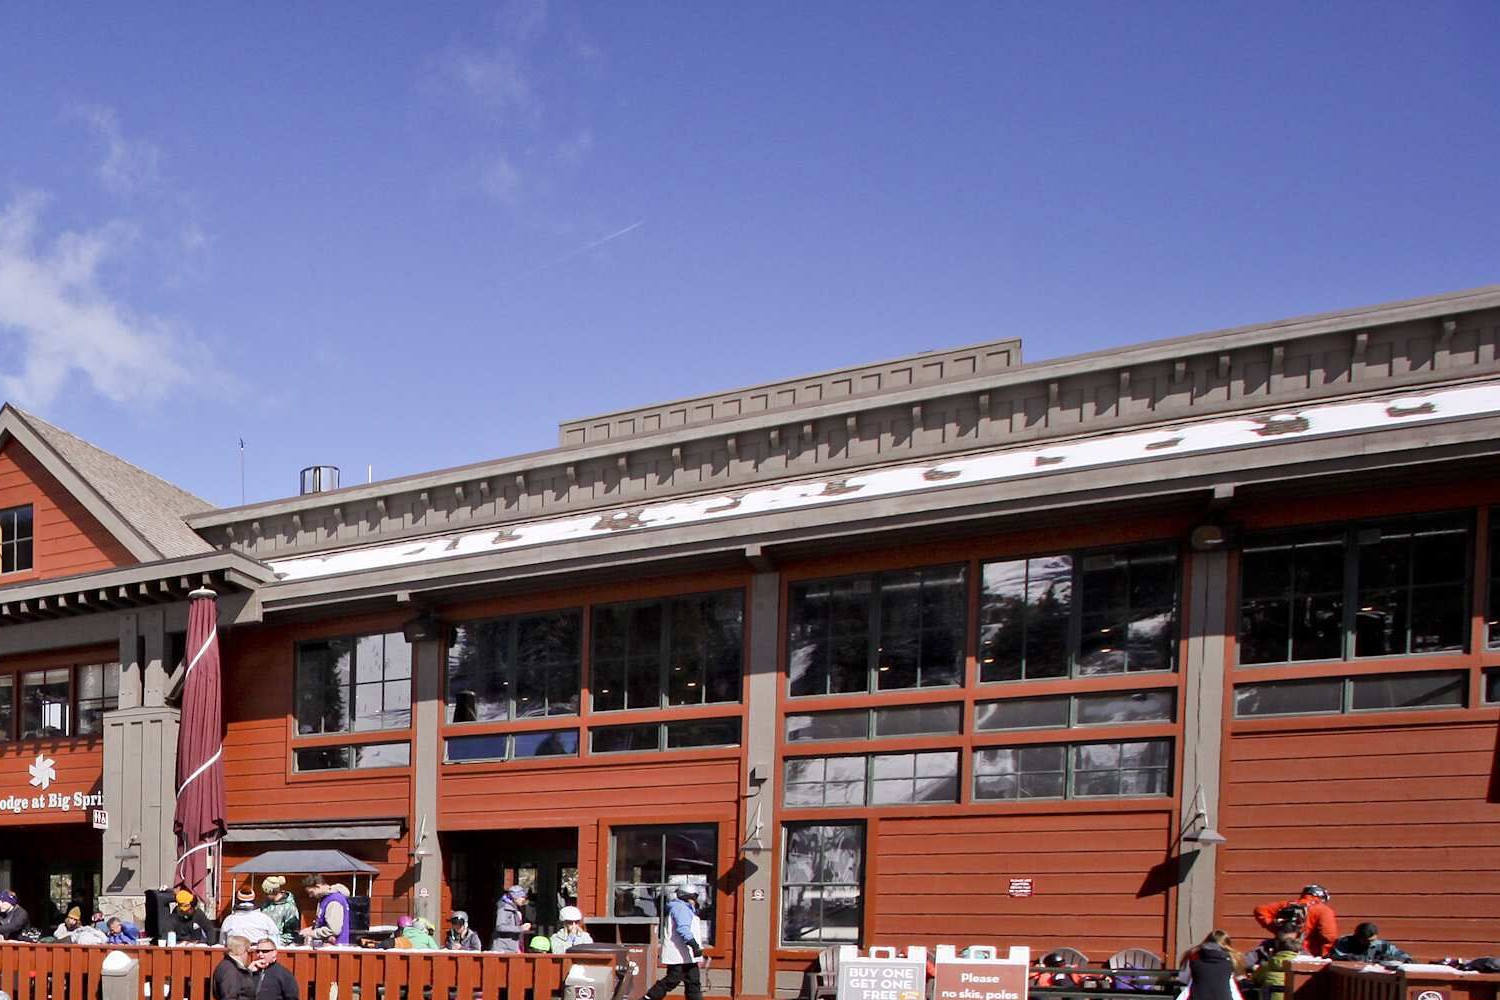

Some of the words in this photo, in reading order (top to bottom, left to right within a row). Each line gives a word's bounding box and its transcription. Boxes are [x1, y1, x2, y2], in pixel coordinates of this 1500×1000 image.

[32, 794, 45, 808] at
[48, 792, 70, 811] Big
[849, 968, 880, 978] BUY
[882, 969, 914, 978] ONE
[961, 973, 999, 983] Please
[850, 980, 878, 989] GET
[881, 980, 913, 990] ONE
[863, 991, 898, 1000] FREE
[986, 990, 1019, 1000] poles
